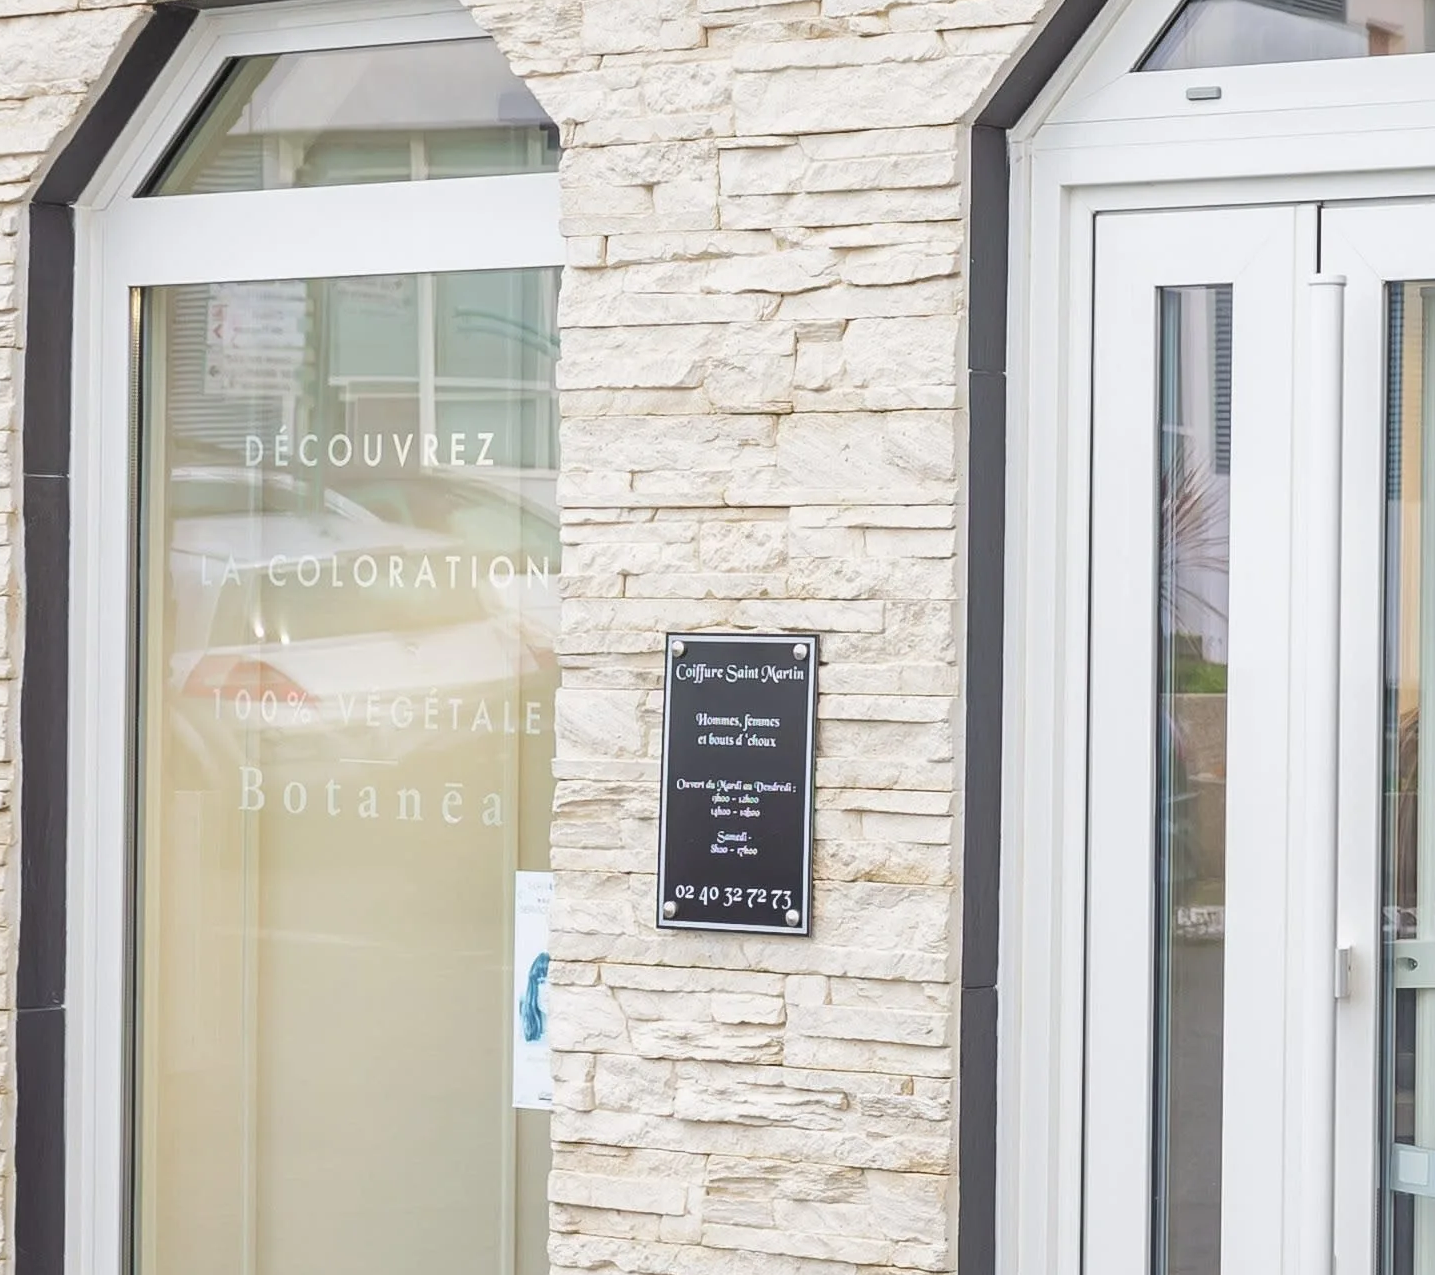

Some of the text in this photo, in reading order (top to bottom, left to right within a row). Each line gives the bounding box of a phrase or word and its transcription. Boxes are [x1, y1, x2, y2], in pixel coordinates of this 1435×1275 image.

[245, 426, 495, 467] DÉCOUVREZ
[201, 554, 549, 589] LA COLORATION
[676, 663, 804, 683] Coiffure Saint Martin
[213, 685, 541, 735] 100% VÉGÉTALE
[675, 884, 792, 910] 02 40 32 72 73
